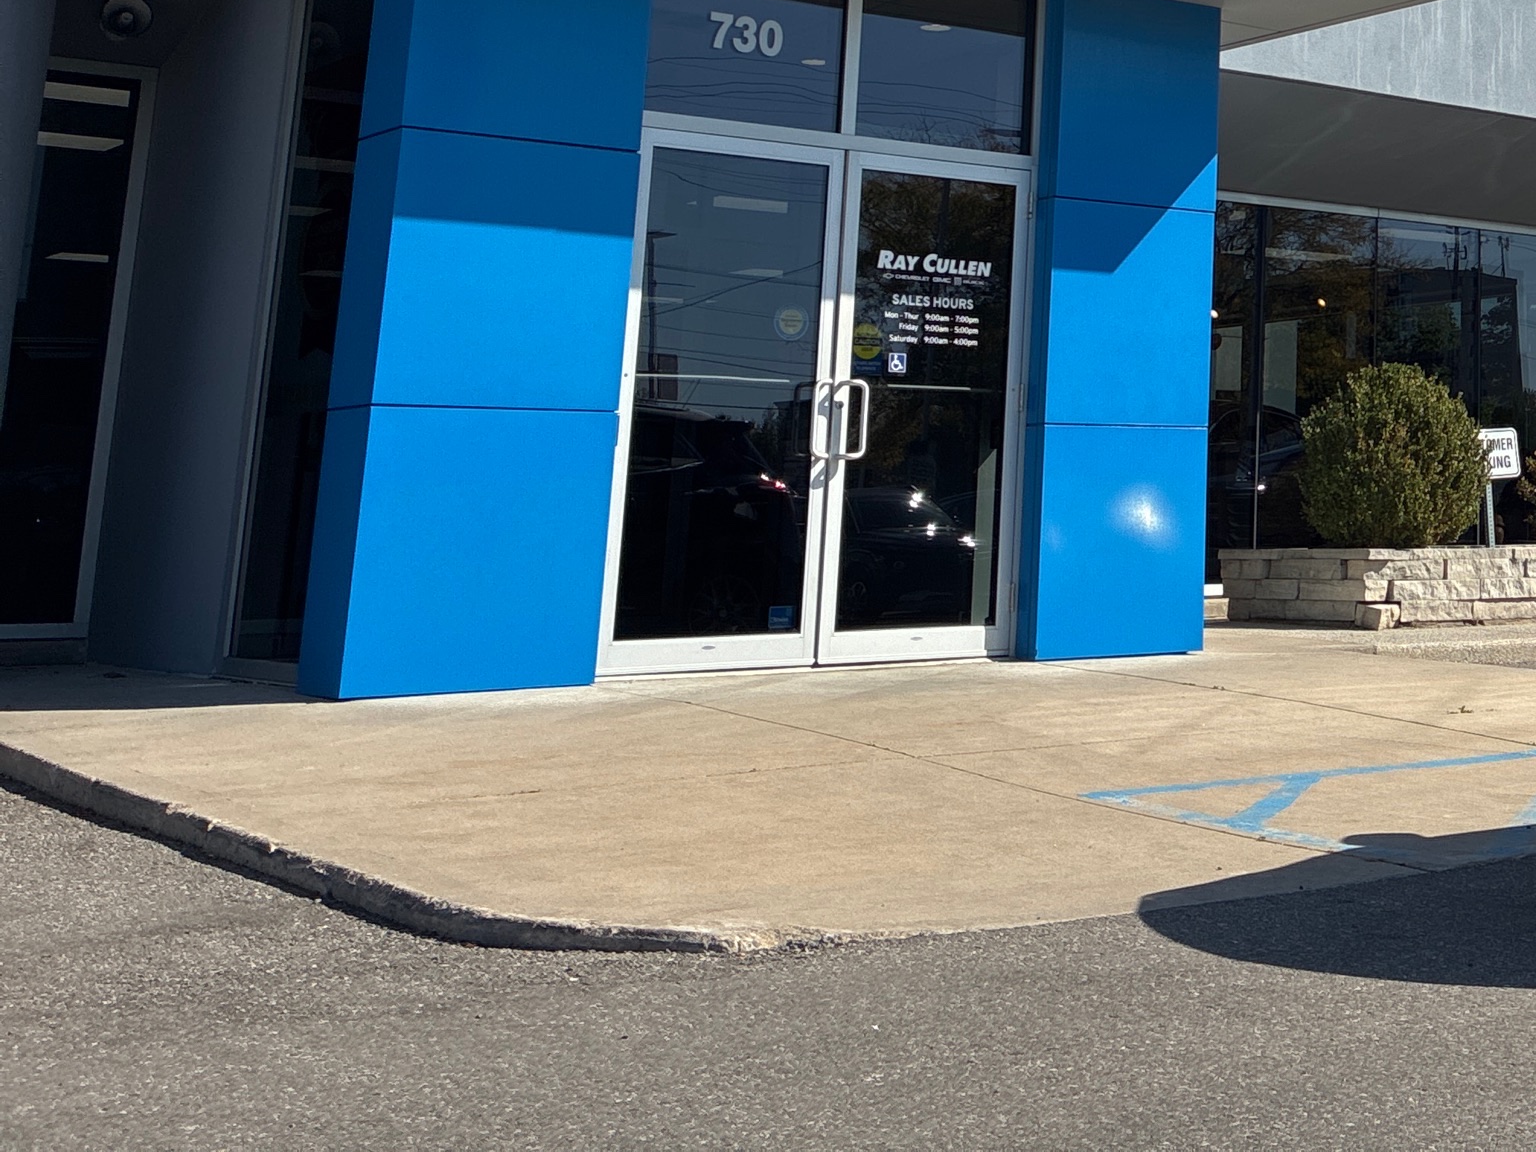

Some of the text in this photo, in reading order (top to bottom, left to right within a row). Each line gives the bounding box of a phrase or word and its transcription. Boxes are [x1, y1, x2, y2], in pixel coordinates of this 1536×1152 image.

[709, 10, 784, 57] 730
[877, 249, 992, 277] RAY CULLEN
[895, 274, 930, 282] CHEVROLET
[892, 294, 974, 310] SALES HOURS
[884, 311, 899, 319] Mon
[904, 312, 919, 320] Thur
[925, 313, 950, 322] 9:00am
[955, 315, 979, 324] 7:00pm
[899, 322, 919, 332] Friday
[924, 324, 949, 333] 9:00am
[954, 326, 979, 335] 5:00pm
[889, 334, 918, 344] Saturday
[923, 336, 949, 345] 9:00am
[953, 338, 978, 347] 4:00pm
[1479, 438, 1513, 451] TOMER
